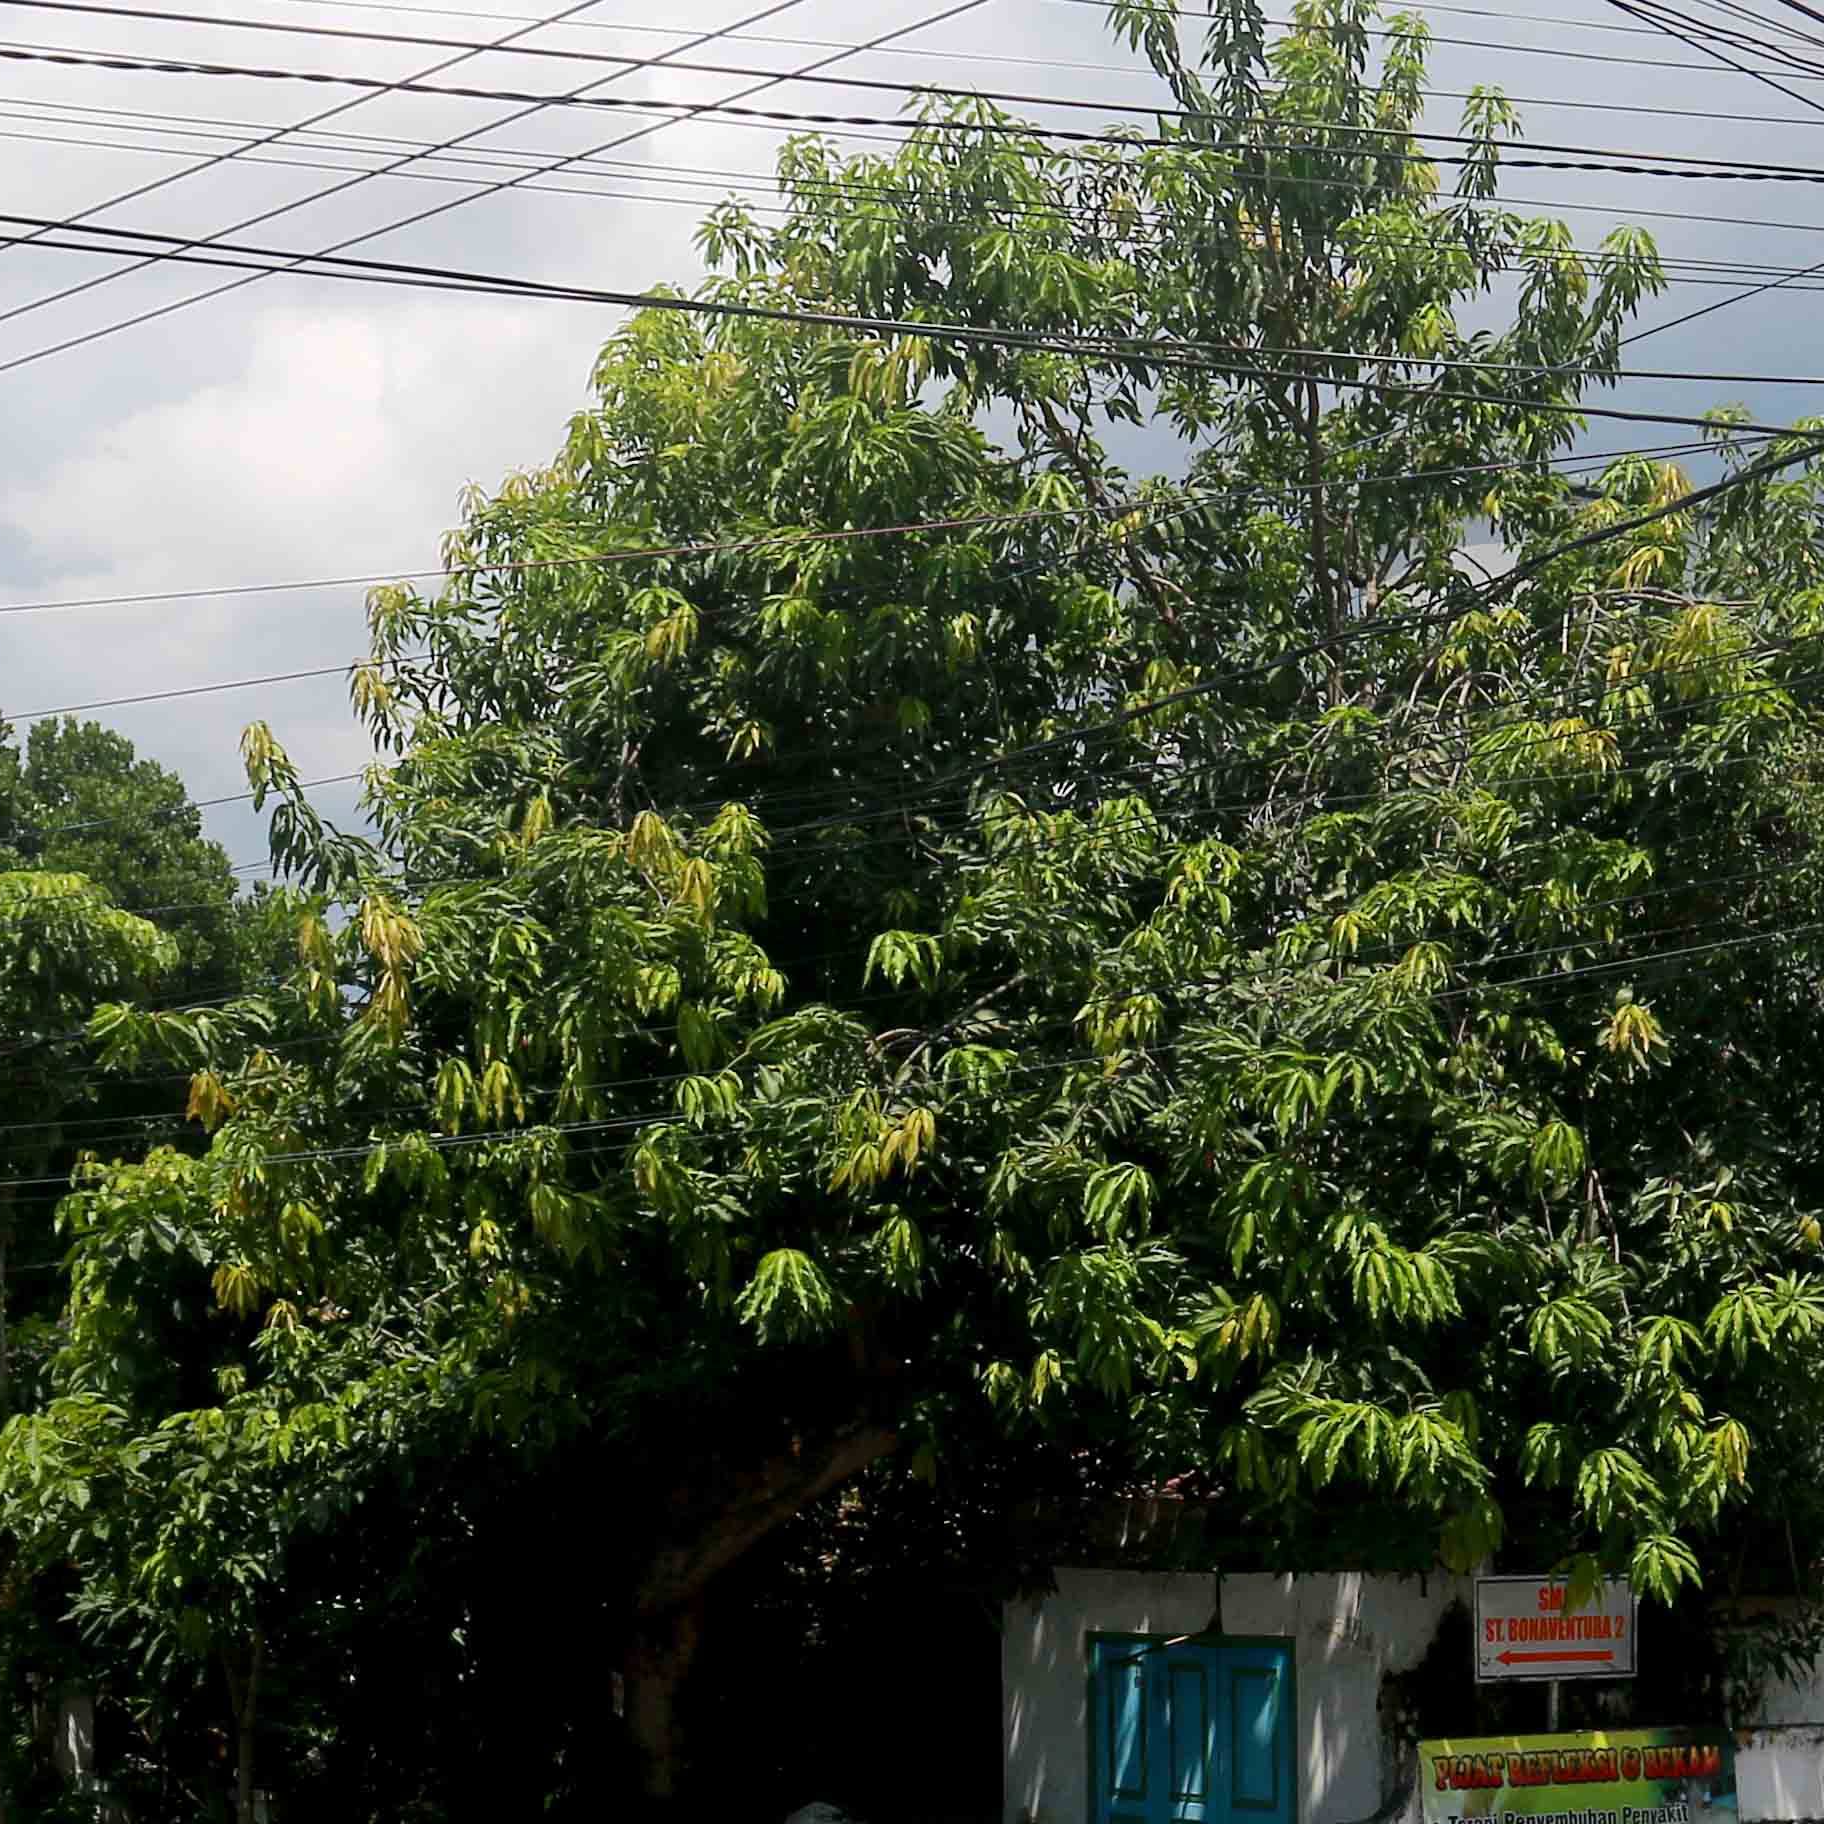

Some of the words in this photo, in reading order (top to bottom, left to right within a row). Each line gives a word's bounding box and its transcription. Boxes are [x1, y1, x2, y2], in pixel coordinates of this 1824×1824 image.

[1486, 1617, 1505, 1642] ST.
[1508, 1615, 1612, 1642] BONAVENTURA
[1615, 1615, 1625, 1638] 2
[1433, 1754, 1504, 1790] PIJAT
[1507, 1748, 1619, 1786] REFLEKSI
[1622, 1747, 1641, 1781] &
[1643, 1745, 1721, 1780] BEKAM
